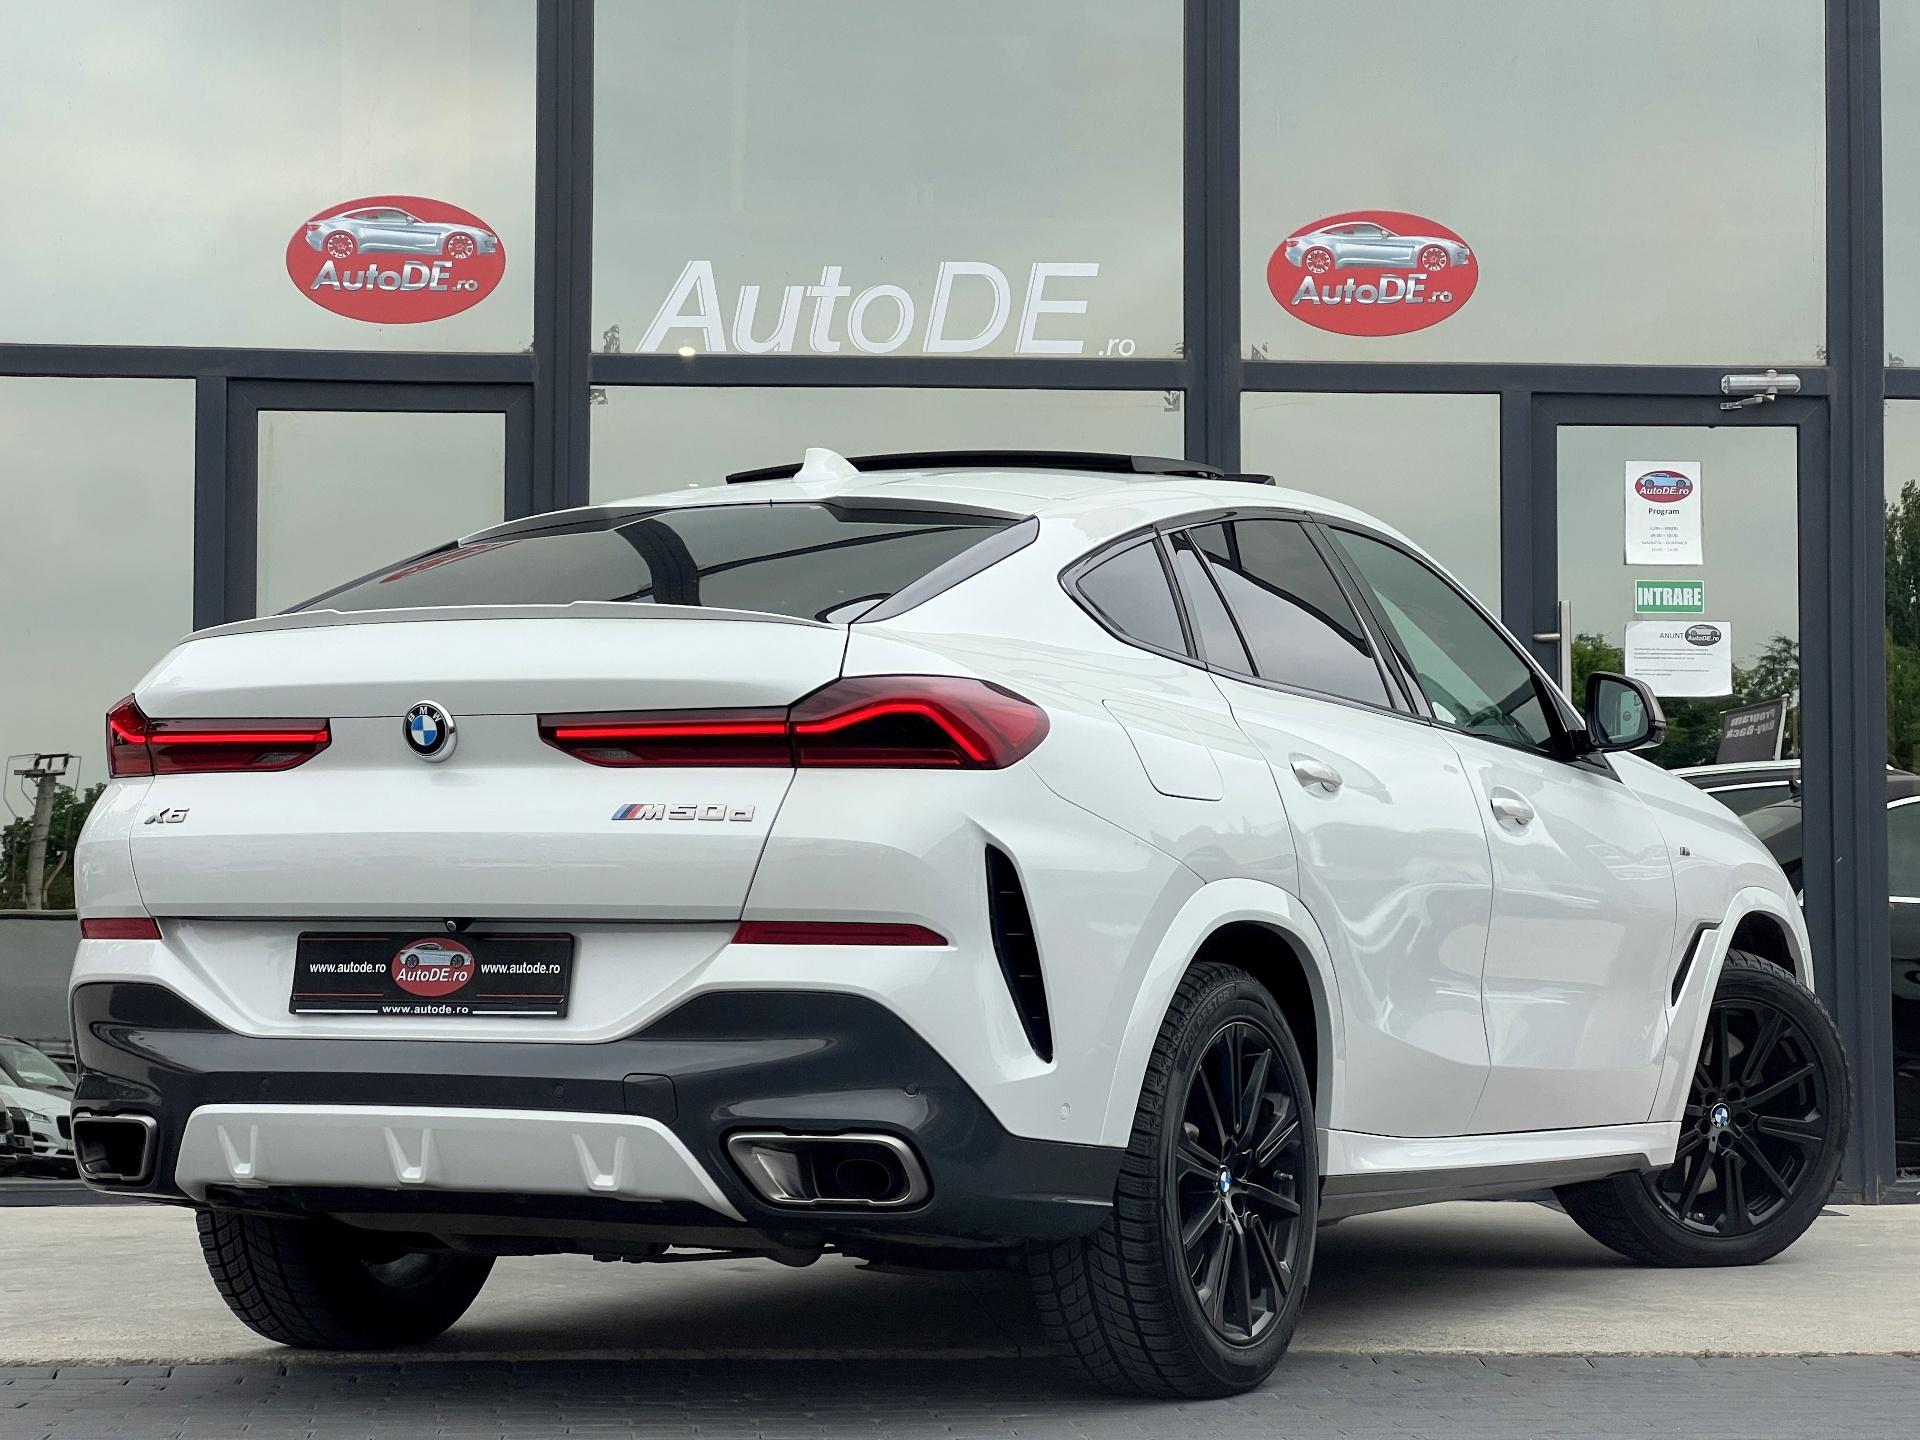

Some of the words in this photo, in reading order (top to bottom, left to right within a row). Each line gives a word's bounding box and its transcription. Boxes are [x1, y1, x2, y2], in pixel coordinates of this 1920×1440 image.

[1639, 486, 1690, 495] AutoDE.ro
[1648, 507, 1680, 516] Program
[1637, 587, 1702, 606] INTRARE
[408, 706, 442, 722] BMW
[143, 807, 190, 825] X6
[309, 961, 387, 974] www.autode.ro
[396, 967, 469, 982] AutoDE.ro
[480, 961, 561, 975] www.autode.ro
[382, 1004, 469, 1015] www.autode.ro
